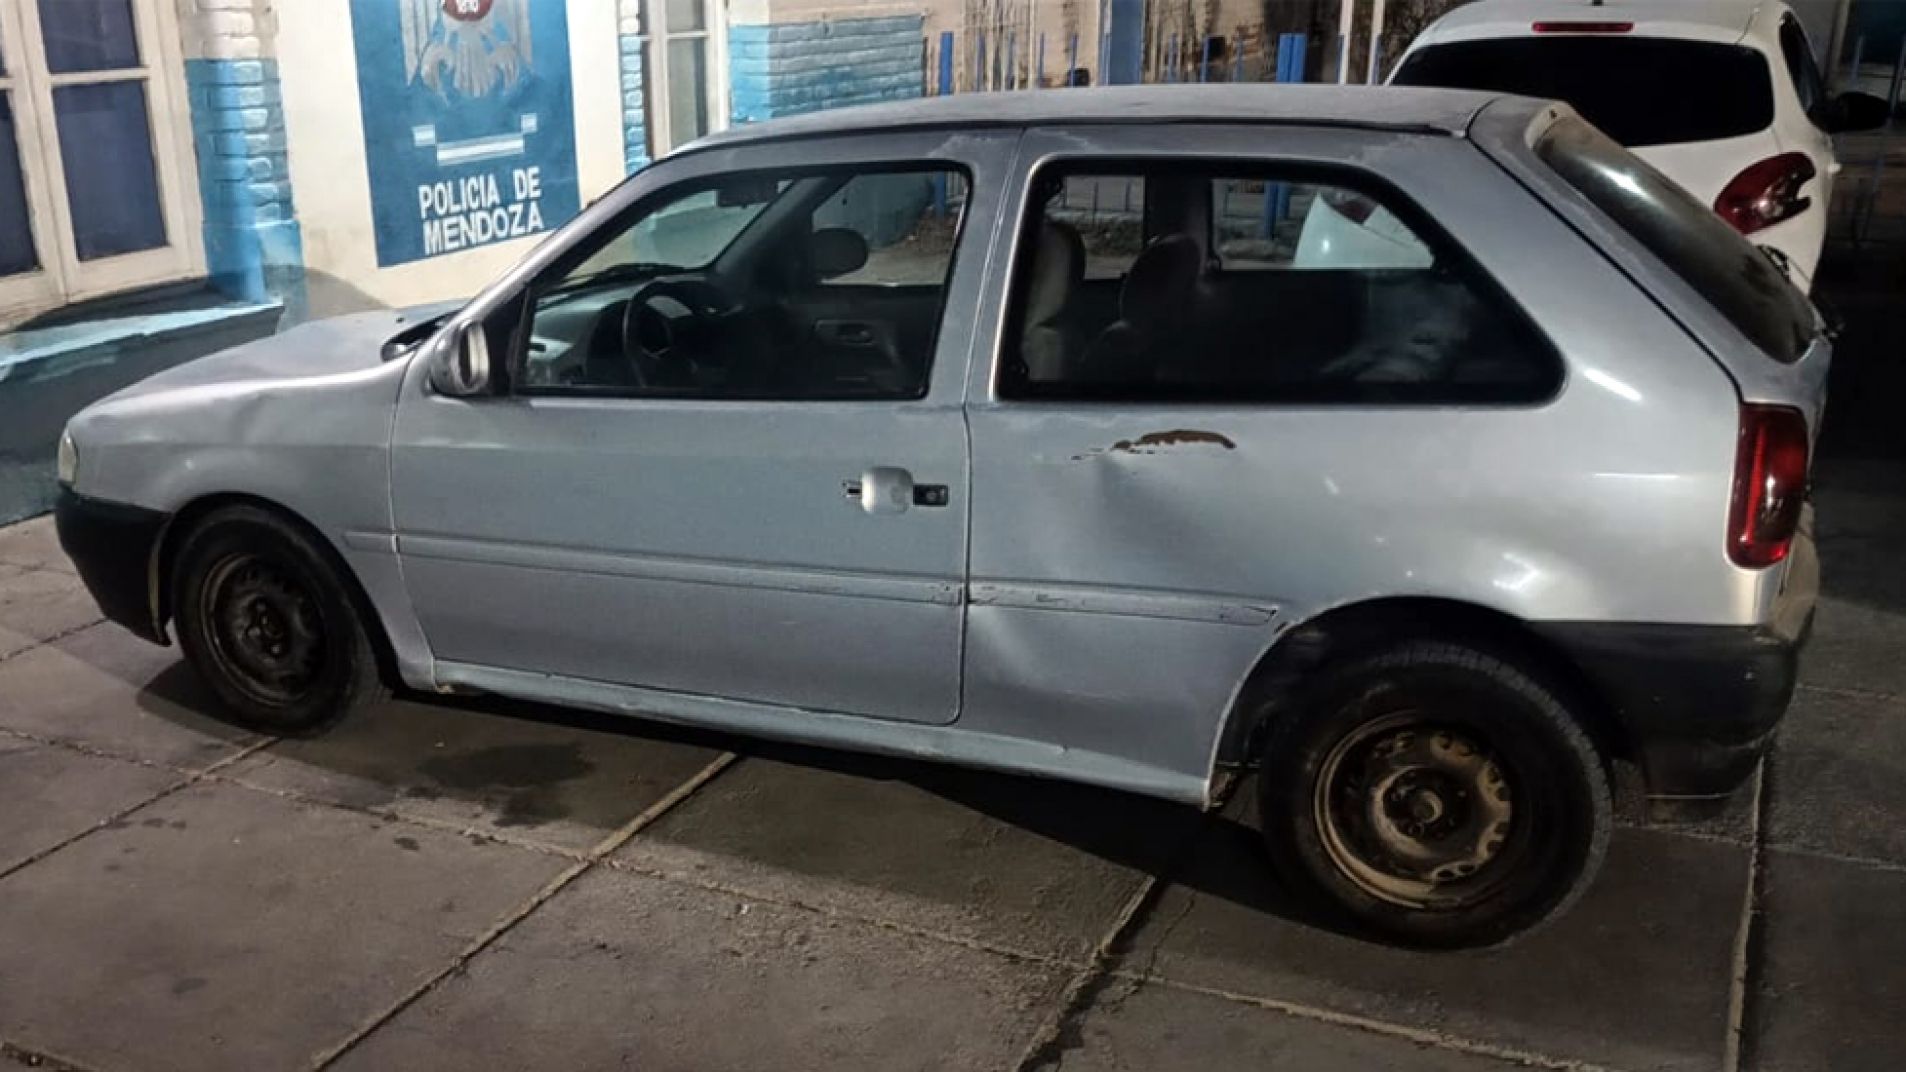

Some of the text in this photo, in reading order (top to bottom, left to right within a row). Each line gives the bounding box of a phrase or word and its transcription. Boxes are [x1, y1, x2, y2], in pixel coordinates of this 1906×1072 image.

[418, 166, 542, 219] POLICIA DE
[423, 202, 545, 256] MENDOZA
